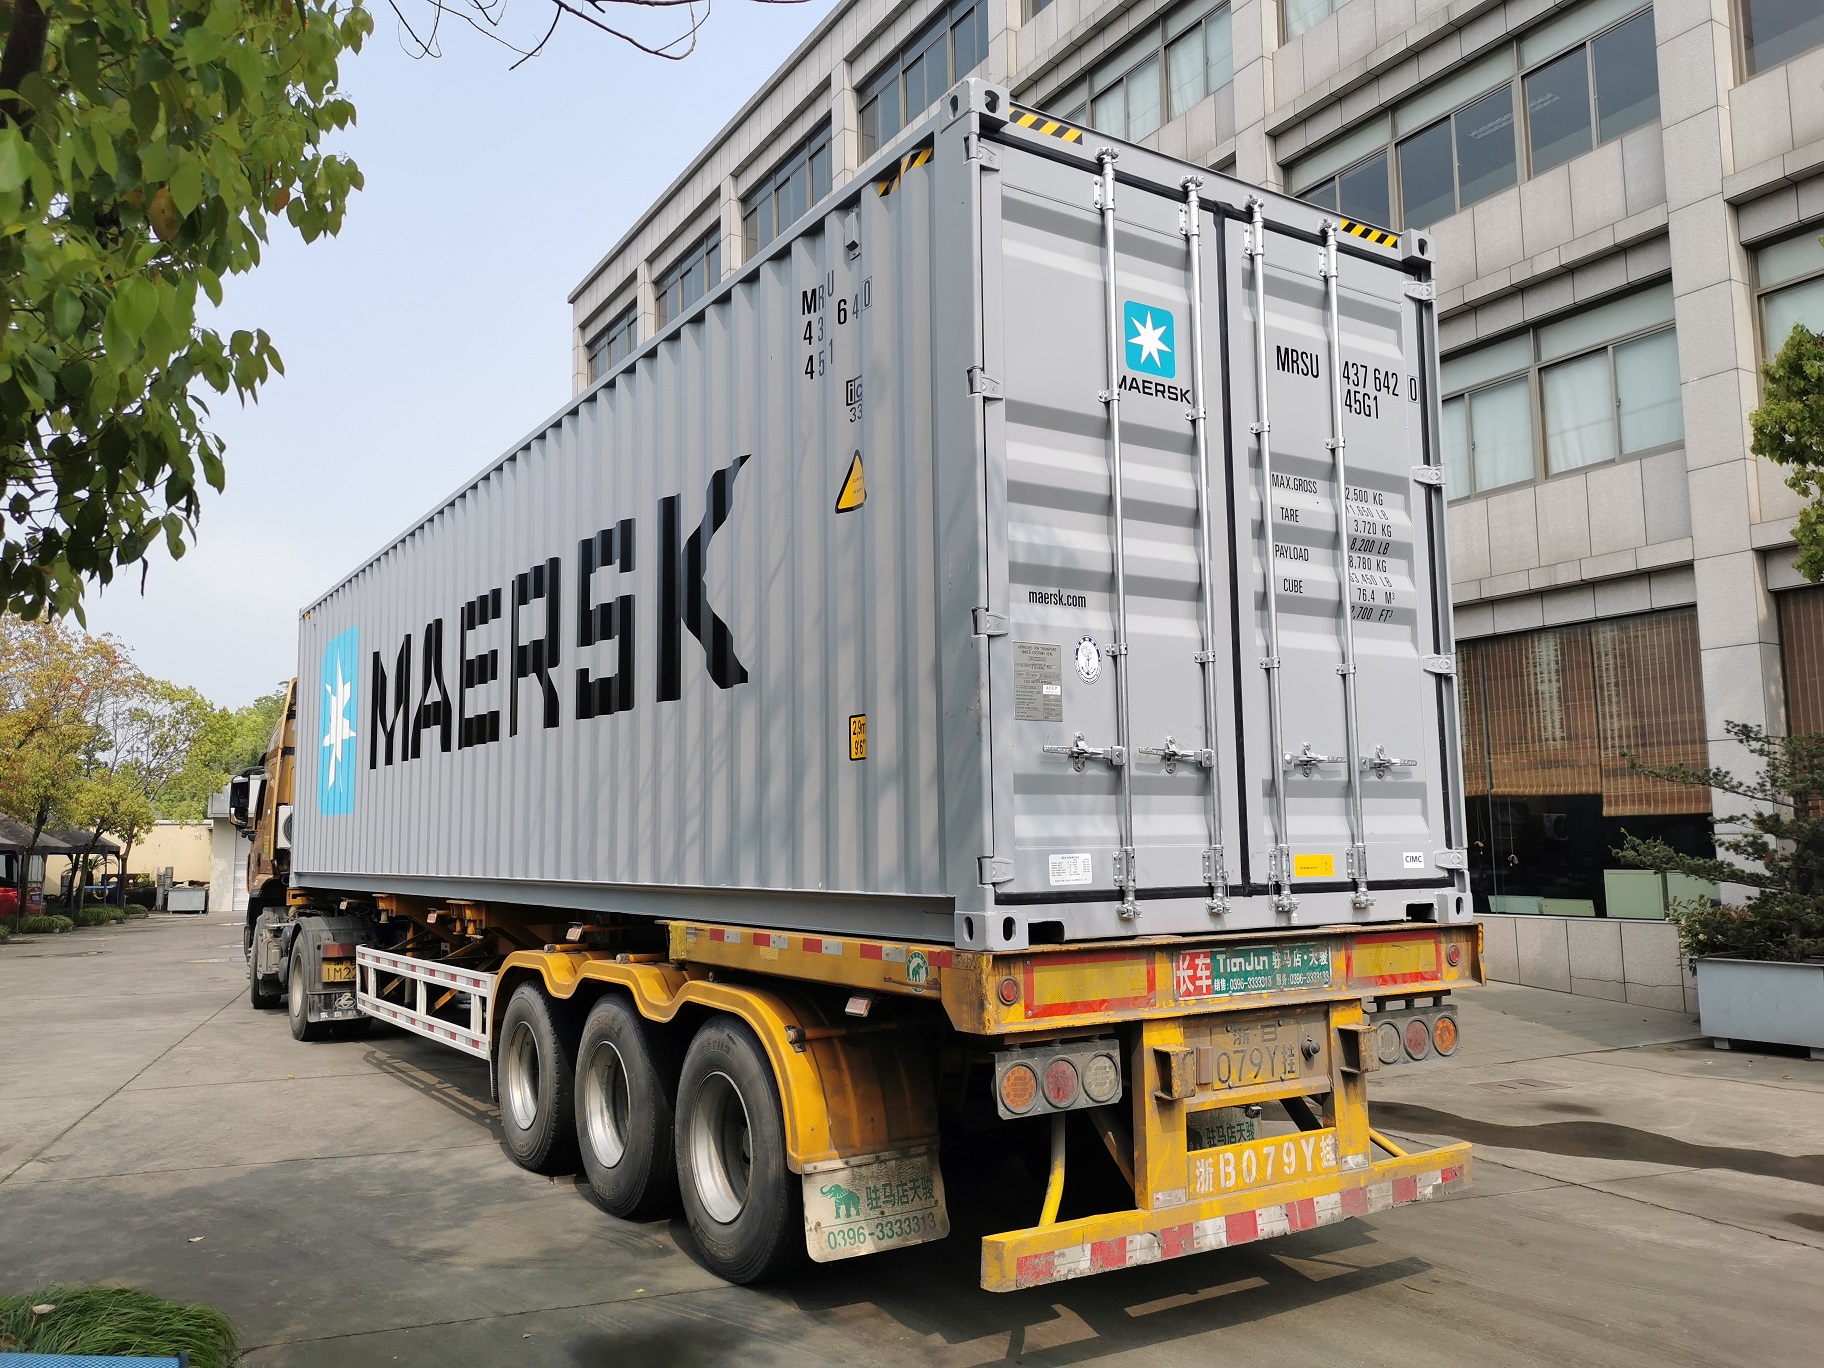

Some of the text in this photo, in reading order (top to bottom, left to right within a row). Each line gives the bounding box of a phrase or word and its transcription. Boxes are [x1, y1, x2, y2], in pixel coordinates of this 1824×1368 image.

[863, 279, 872, 308] 0
[1276, 345, 1418, 401] MRSU 437 642 0
[1344, 389, 1379, 419] 45G1
[1271, 473, 1318, 494] MAX.GROSS
[1372, 491, 1384, 506] KG
[1280, 506, 1392, 538] TARE 3,720 KG
[1375, 509, 1389, 521] LB
[1274, 544, 1309, 562] PAYLOAD
[1376, 559, 1387, 573] KG
[1350, 537, 1390, 555] 8,200 LB
[1283, 578, 1304, 594] CUBE
[1357, 587, 1375, 603] 76.4
[1378, 575, 1393, 588] LB
[369, 454, 753, 770] MAERSK
[1028, 588, 1087, 608] maersk.com
[1404, 855, 1422, 863] CIMC
[1176, 953, 1212, 996] 长车
[865, 1174, 935, 1211] 驻马店天骏
